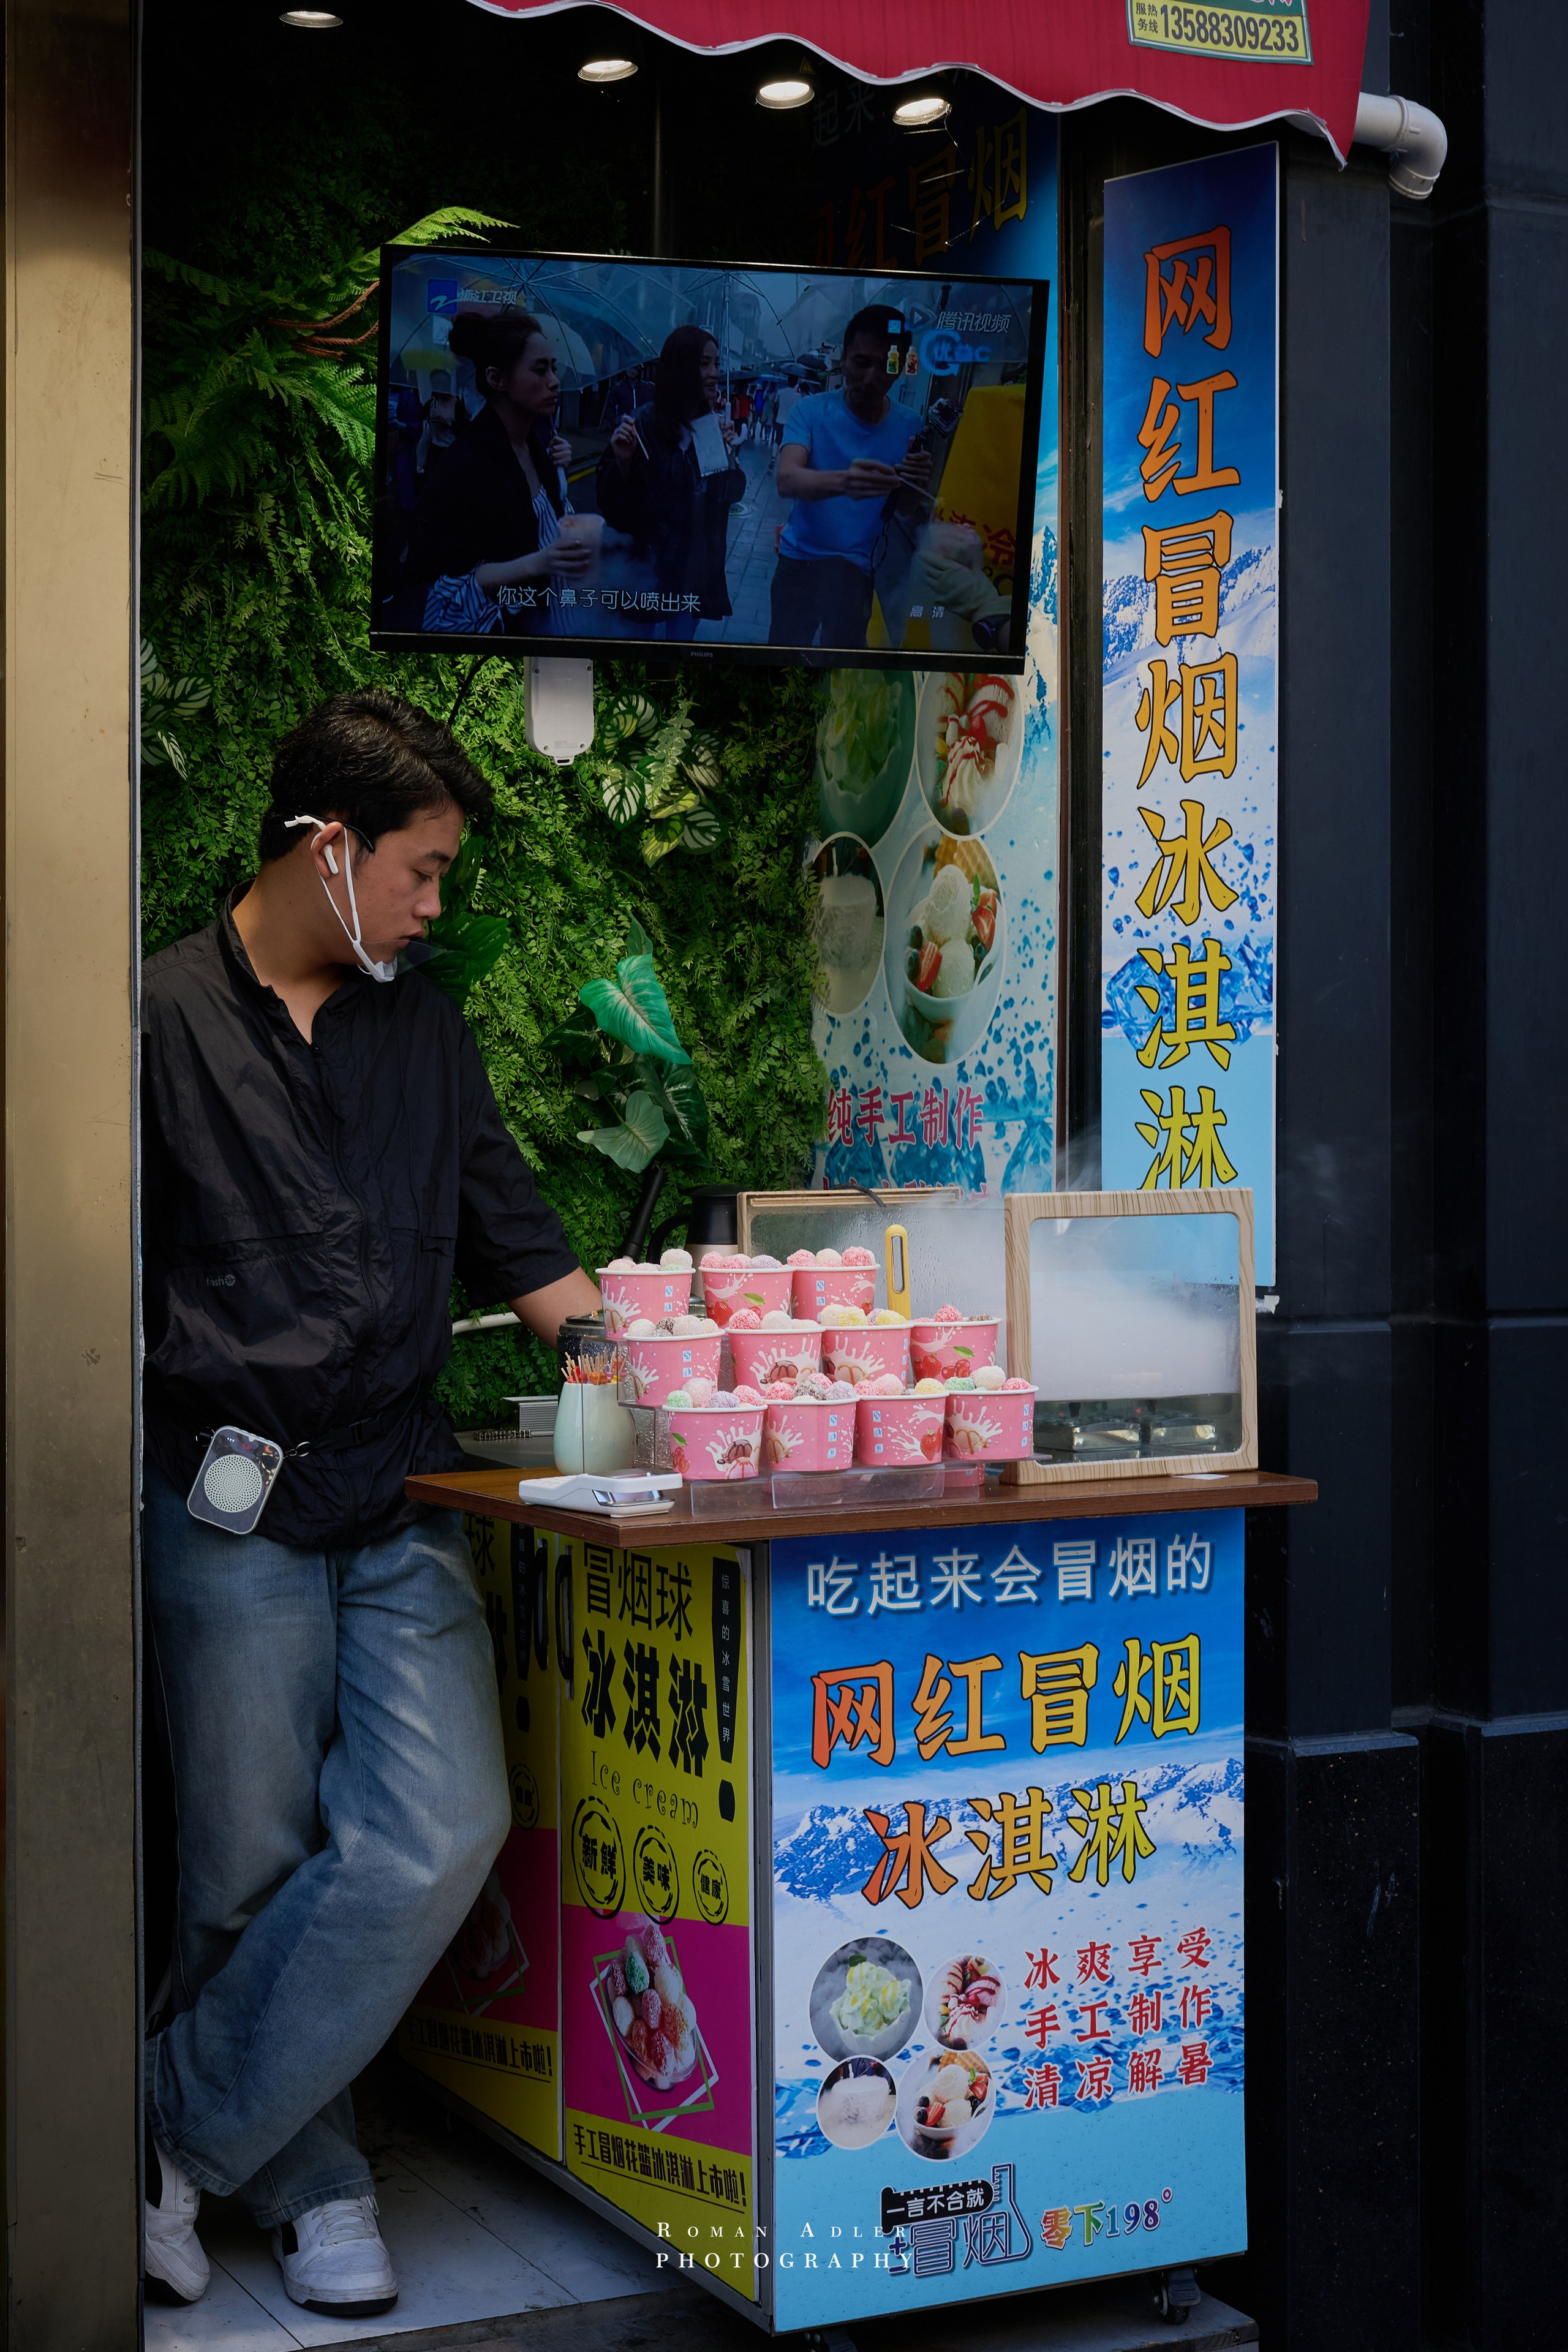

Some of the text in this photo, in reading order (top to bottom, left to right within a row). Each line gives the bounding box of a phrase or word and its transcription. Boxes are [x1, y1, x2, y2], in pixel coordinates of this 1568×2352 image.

[1160, 5, 1299, 52] 13588309233
[935, 311, 1012, 333] 腾讯视频
[497, 584, 701, 612] 你这个鼻子可以喷出来
[910, 605, 945, 619] 高清
[1134, 224, 1240, 1189] 网红冒烟冰淇淋
[827, 1085, 984, 1151] 纯手工制作
[584, 1542, 693, 1642] 冒烟球
[806, 1532, 1212, 1616] 吃起来会冒烟的
[720, 1573, 731, 1744] 惊喜的冰雪世界
[811, 1632, 1200, 1769] 网红冒烟
[591, 1750, 699, 1829] Ice cream
[643, 1855, 671, 1892] 美味
[861, 1781, 1156, 1910] 冰淇淋
[700, 1872, 722, 1901] 健康
[1023, 1926, 1212, 1991] 冰爽享受
[1024, 1985, 1212, 2049] 手工制作
[1023, 2041, 1213, 2108] 清凉解暑
[886, 2188, 985, 2218] 一言不合就
